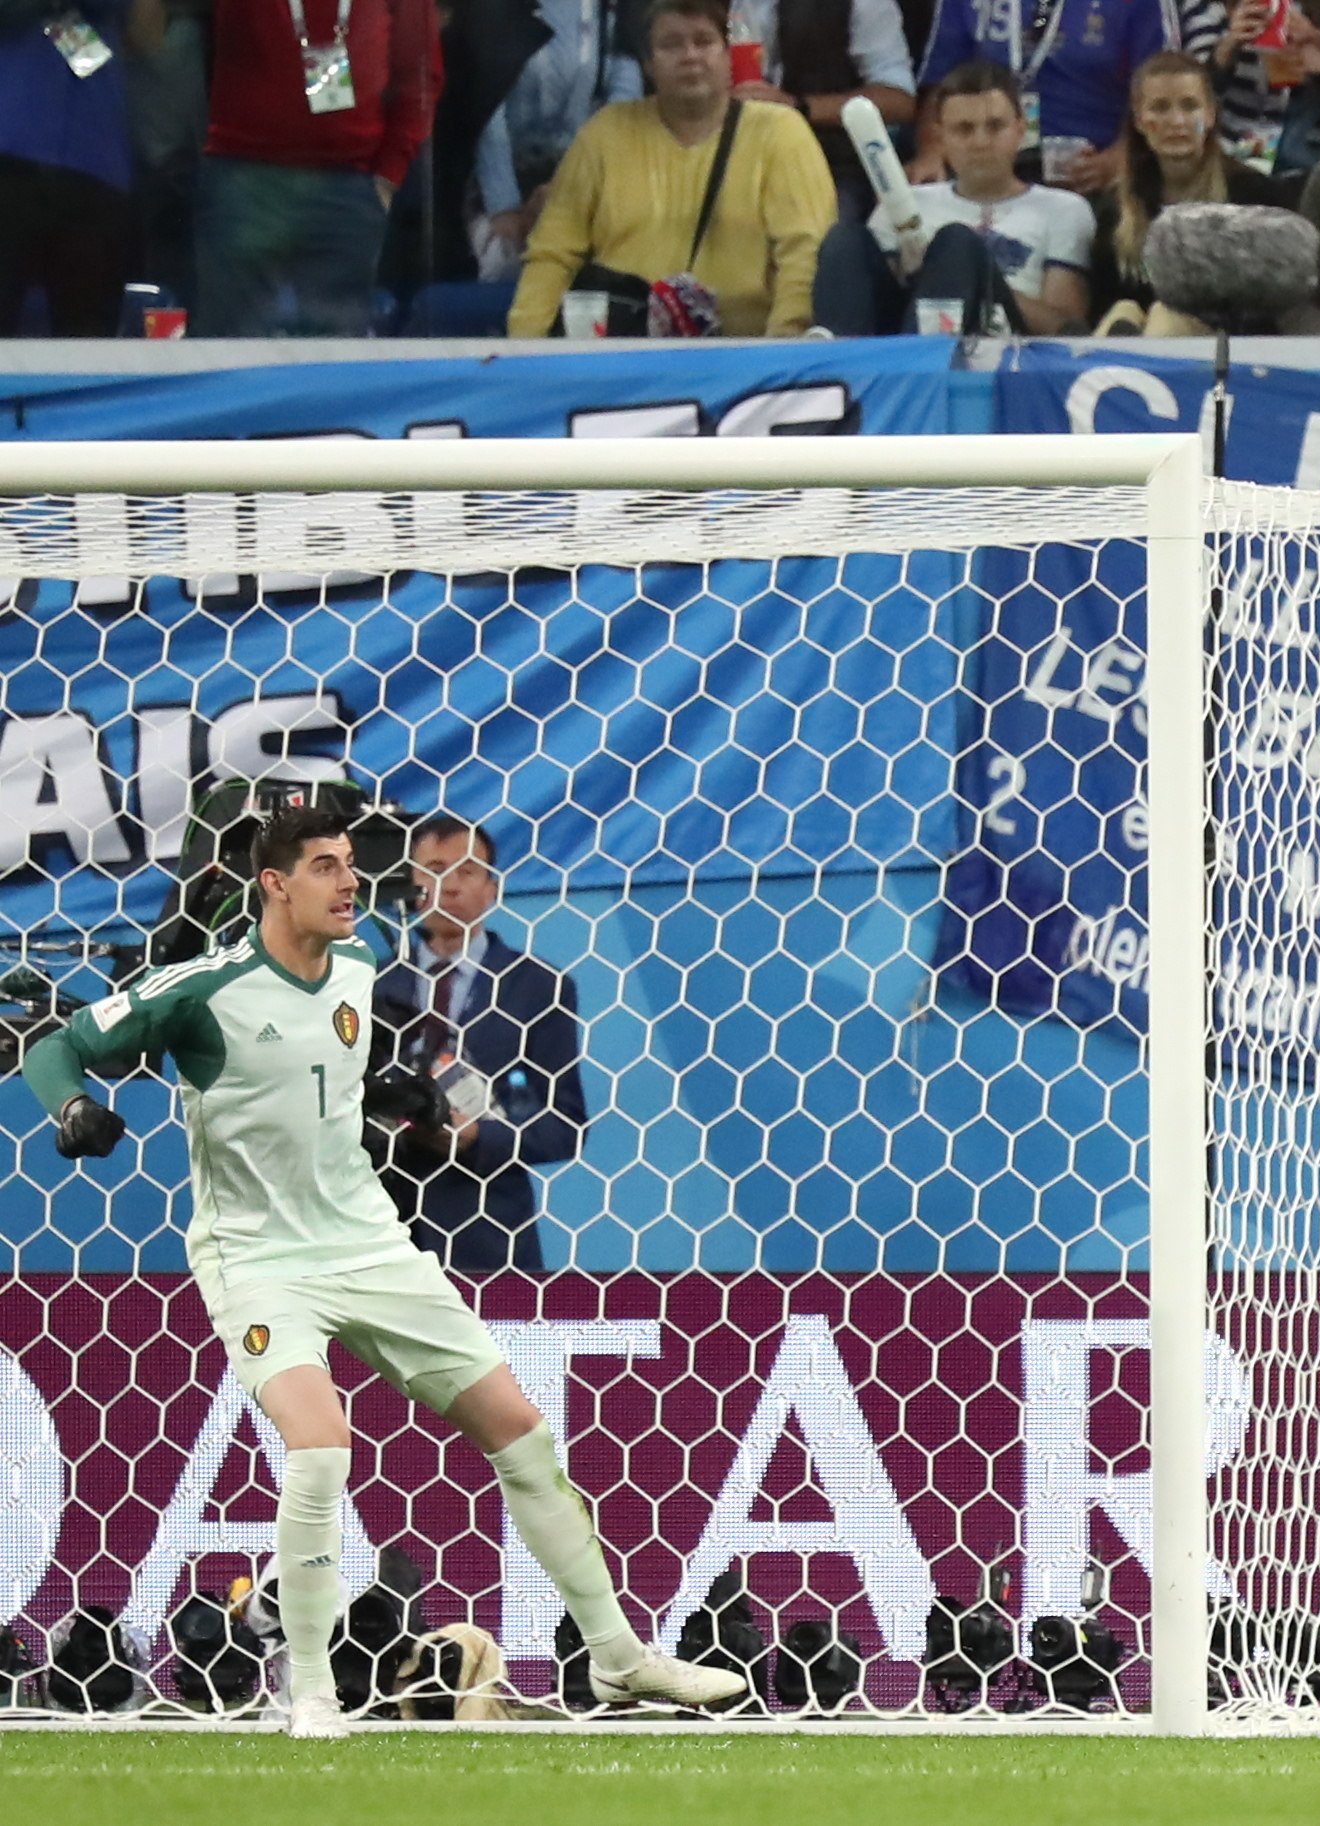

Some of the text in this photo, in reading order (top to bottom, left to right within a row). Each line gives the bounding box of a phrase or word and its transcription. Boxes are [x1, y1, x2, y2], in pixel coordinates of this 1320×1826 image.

[986, 755, 1027, 835] 2
[311, 1064, 325, 1119] 1
[0, 1314, 1249, 1662] ATAR
